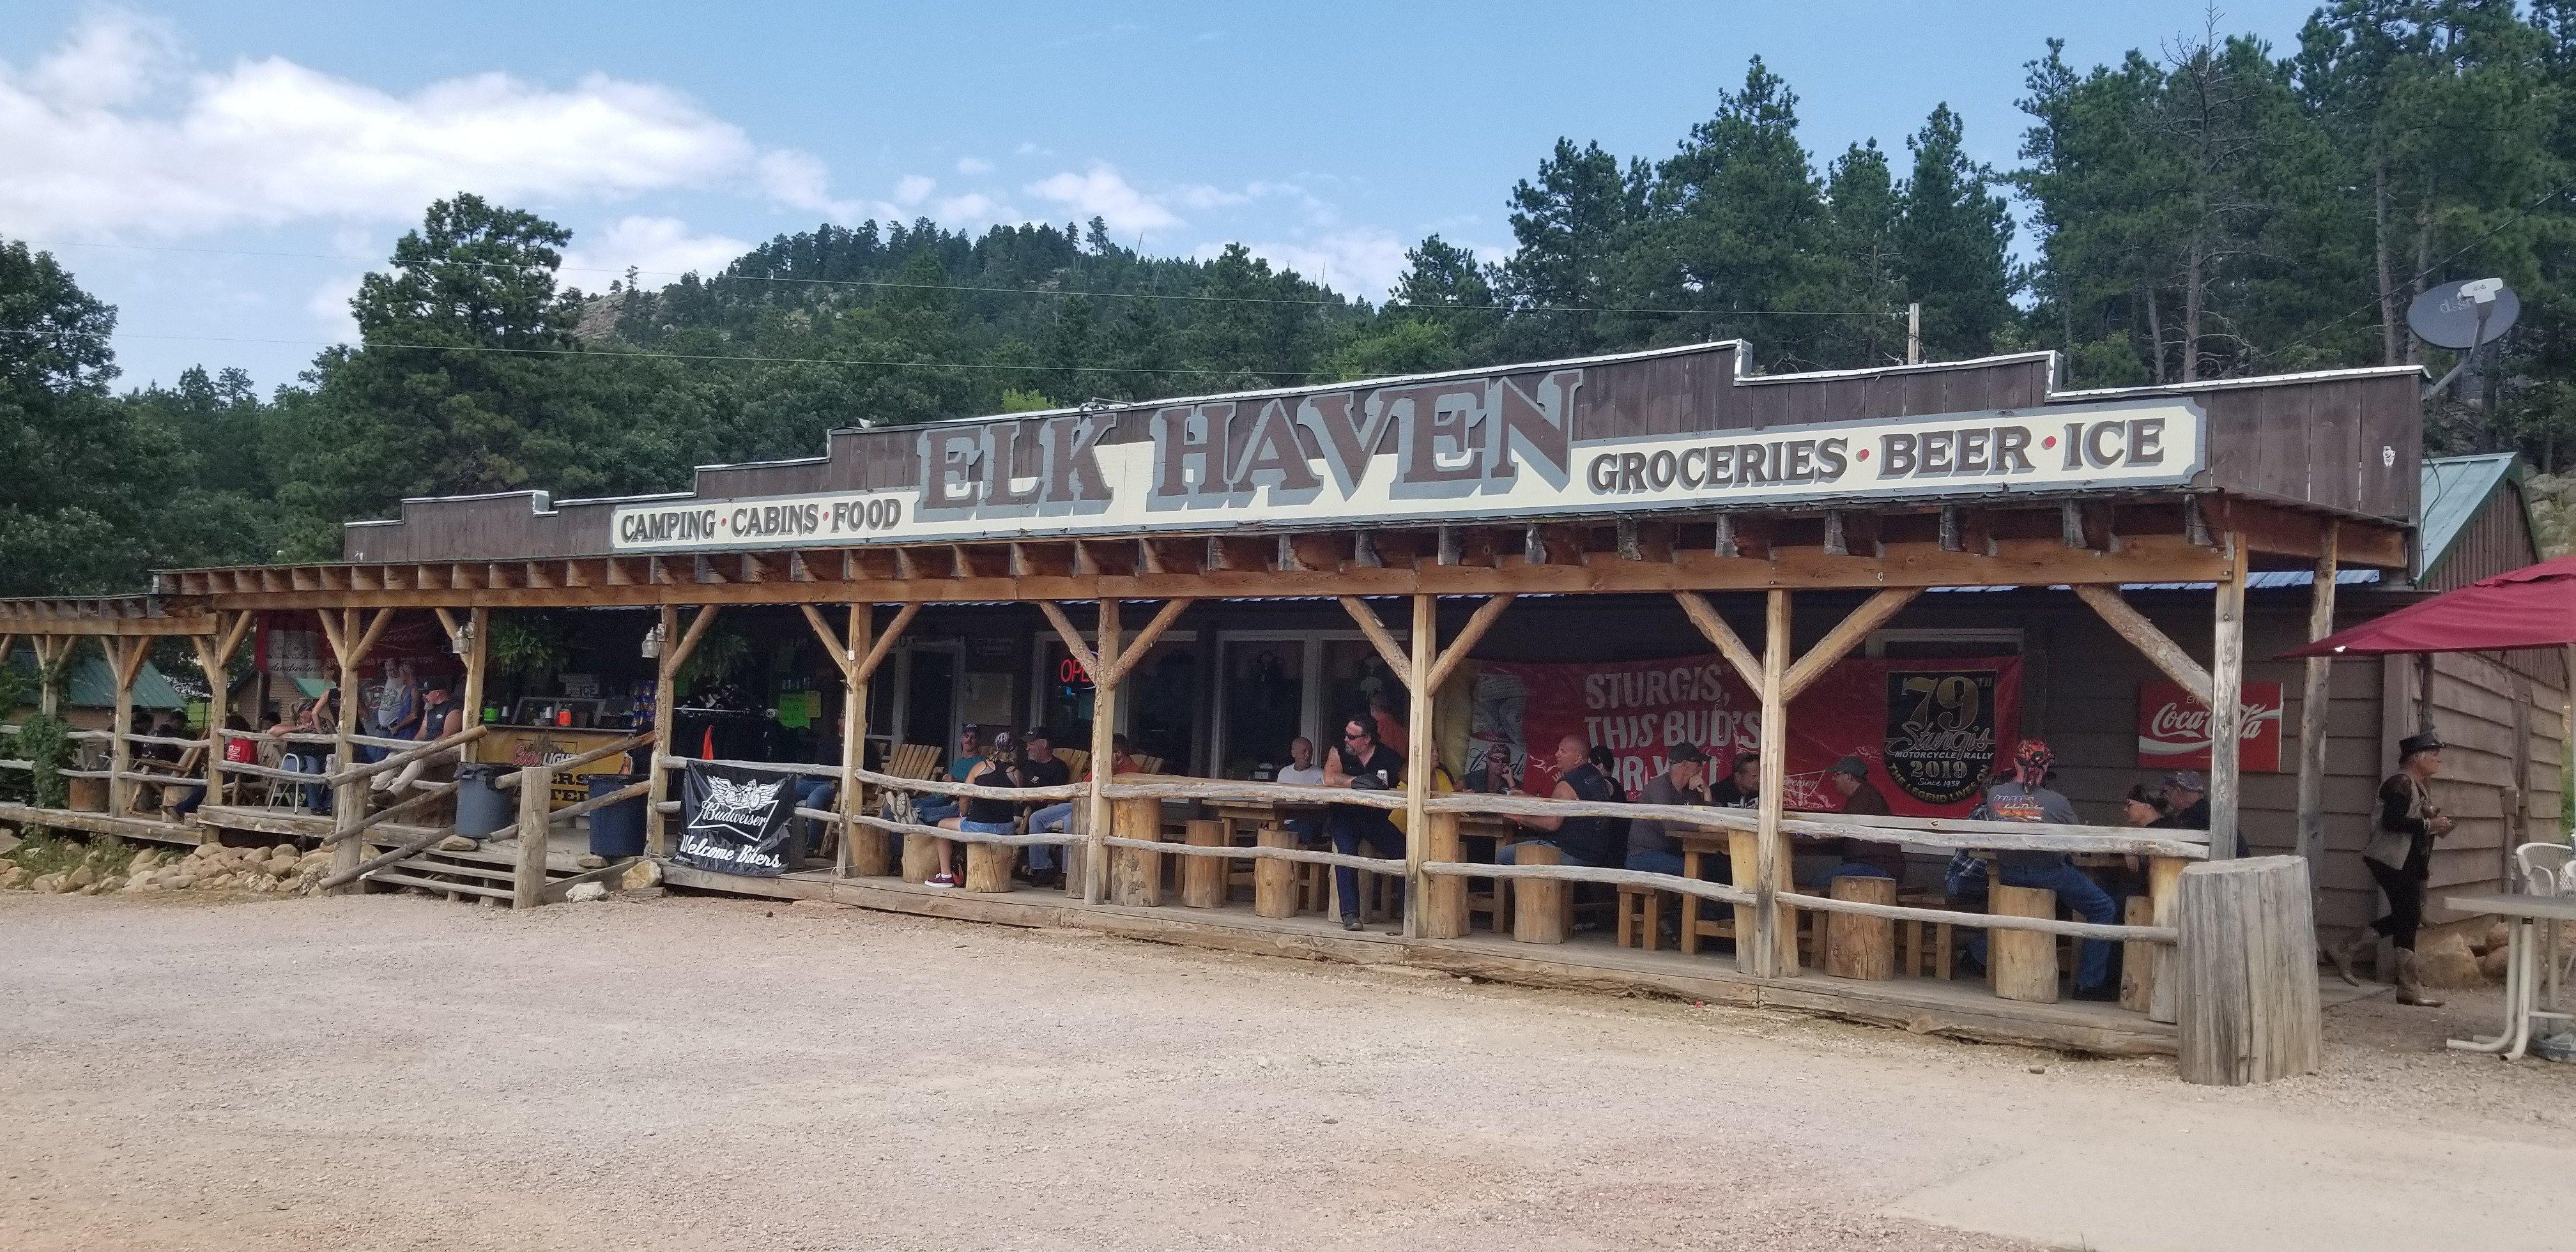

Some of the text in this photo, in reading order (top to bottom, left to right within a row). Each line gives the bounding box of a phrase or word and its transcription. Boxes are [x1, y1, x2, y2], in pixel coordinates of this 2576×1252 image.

[915, 369, 1584, 521] ELK HAVEN
[1588, 416, 2166, 495] GROCERIES BEER ICE
[620, 497, 902, 544] CAMPING CABINS FOOD
[1585, 664, 1731, 710] STURGIS,
[1901, 676, 1979, 731] 79
[1584, 710, 1761, 750] THIS BUD'S
[1885, 722, 1995, 760] Sturgis
[1894, 751, 1958, 760] MOTORCYCLE
[1910, 760, 1968, 779] 2019
[1905, 783, 1947, 802] LEGEND
[1918, 777, 1941, 786] Since
[702, 800, 767, 827] Budweiser
[680, 834, 783, 868] Welcome Bikers
